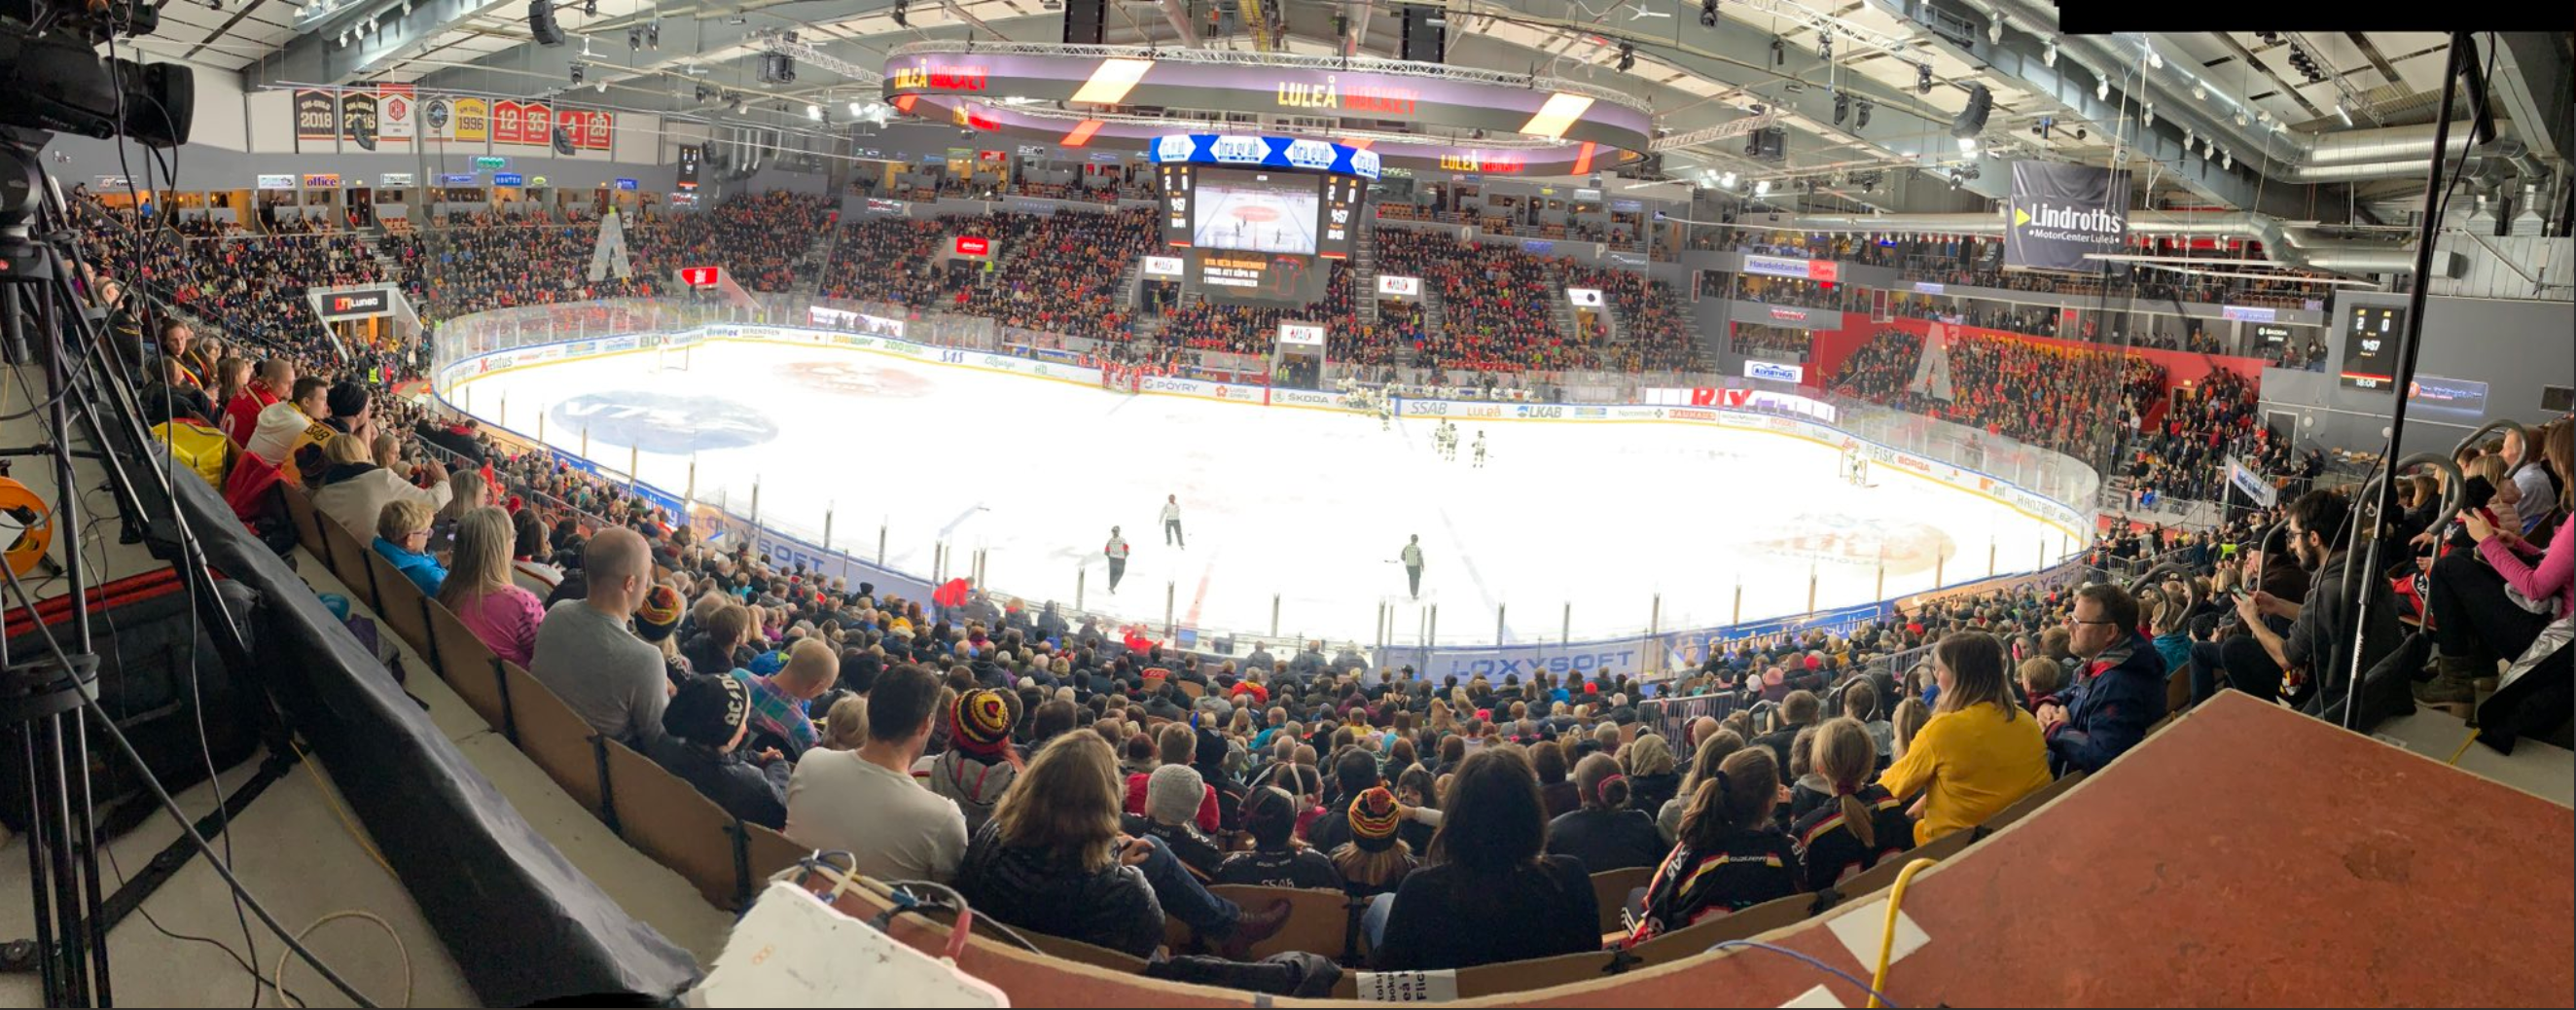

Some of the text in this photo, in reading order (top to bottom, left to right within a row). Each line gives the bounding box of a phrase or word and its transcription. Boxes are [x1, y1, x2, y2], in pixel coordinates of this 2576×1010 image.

[1277, 75, 1419, 115] LULEÅ HOCKEY
[300, 112, 334, 128] 2018
[345, 112, 376, 130] 216
[458, 117, 484, 130] 1996
[498, 110, 518, 130] 12
[527, 111, 548, 132] 35
[1441, 149, 1479, 172] LULEÅ
[306, 176, 337, 187] office
[2031, 203, 2122, 234] Lindroths
[2034, 229, 2115, 244] MotorCenter Luleå
[2356, 316, 2390, 332] 2 0
[480, 356, 513, 374] Xentus
[939, 350, 964, 364] SAS
[1411, 402, 1448, 415] SSAB
[1529, 405, 1562, 418] LKAB
[1874, 447, 1895, 465] FISK
[1452, 650, 1634, 677] LOXYSOFT
